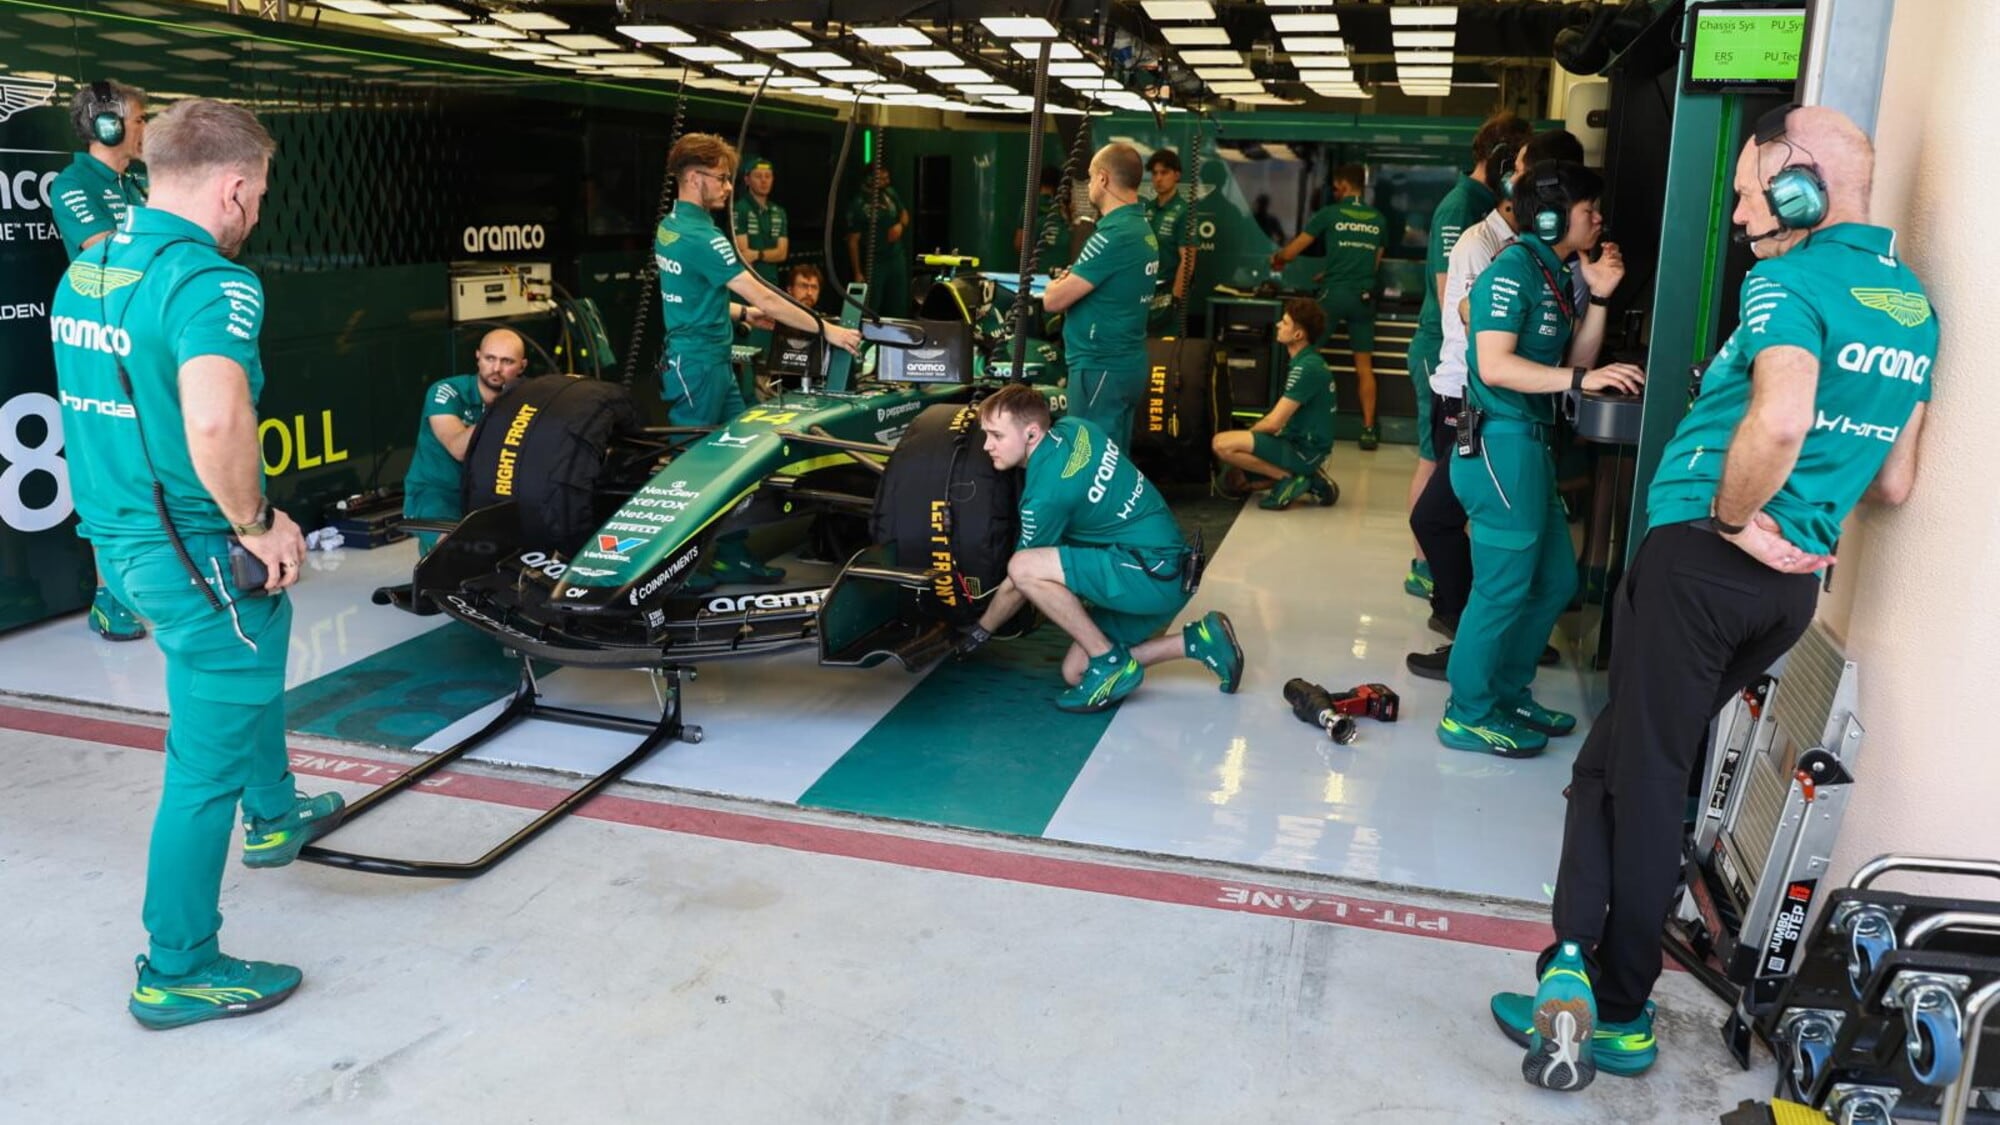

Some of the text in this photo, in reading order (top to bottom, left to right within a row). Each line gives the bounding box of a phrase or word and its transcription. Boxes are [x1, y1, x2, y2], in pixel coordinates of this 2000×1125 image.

[1700, 20, 1756, 32] Chassis Sys
[1771, 20, 1785, 30] PU
[1714, 52, 1733, 61] ERS
[1764, 52, 1779, 61] PU
[25, 223, 62, 240] TEA
[1335, 222, 1380, 235] aramco
[463, 224, 545, 253] aramco
[0, 302, 46, 320] DEN
[50, 315, 132, 357] ramco
[906, 363, 946, 373] aramco
[1149, 366, 1167, 431] LEFT REAR
[740, 409, 799, 426] 14
[495, 403, 538, 496] RIGHT FRONT
[640, 486, 700, 499] NexGen
[627, 497, 690, 510] xerox
[614, 510, 676, 523] NetApp
[638, 546, 699, 599] COINPAYMENTS
[932, 552, 957, 606] FRONT
[1217, 886, 1449, 932] PIT-LANE
[1784, 904, 1805, 941] STEP
[1770, 912, 1791, 954] JUMBO
